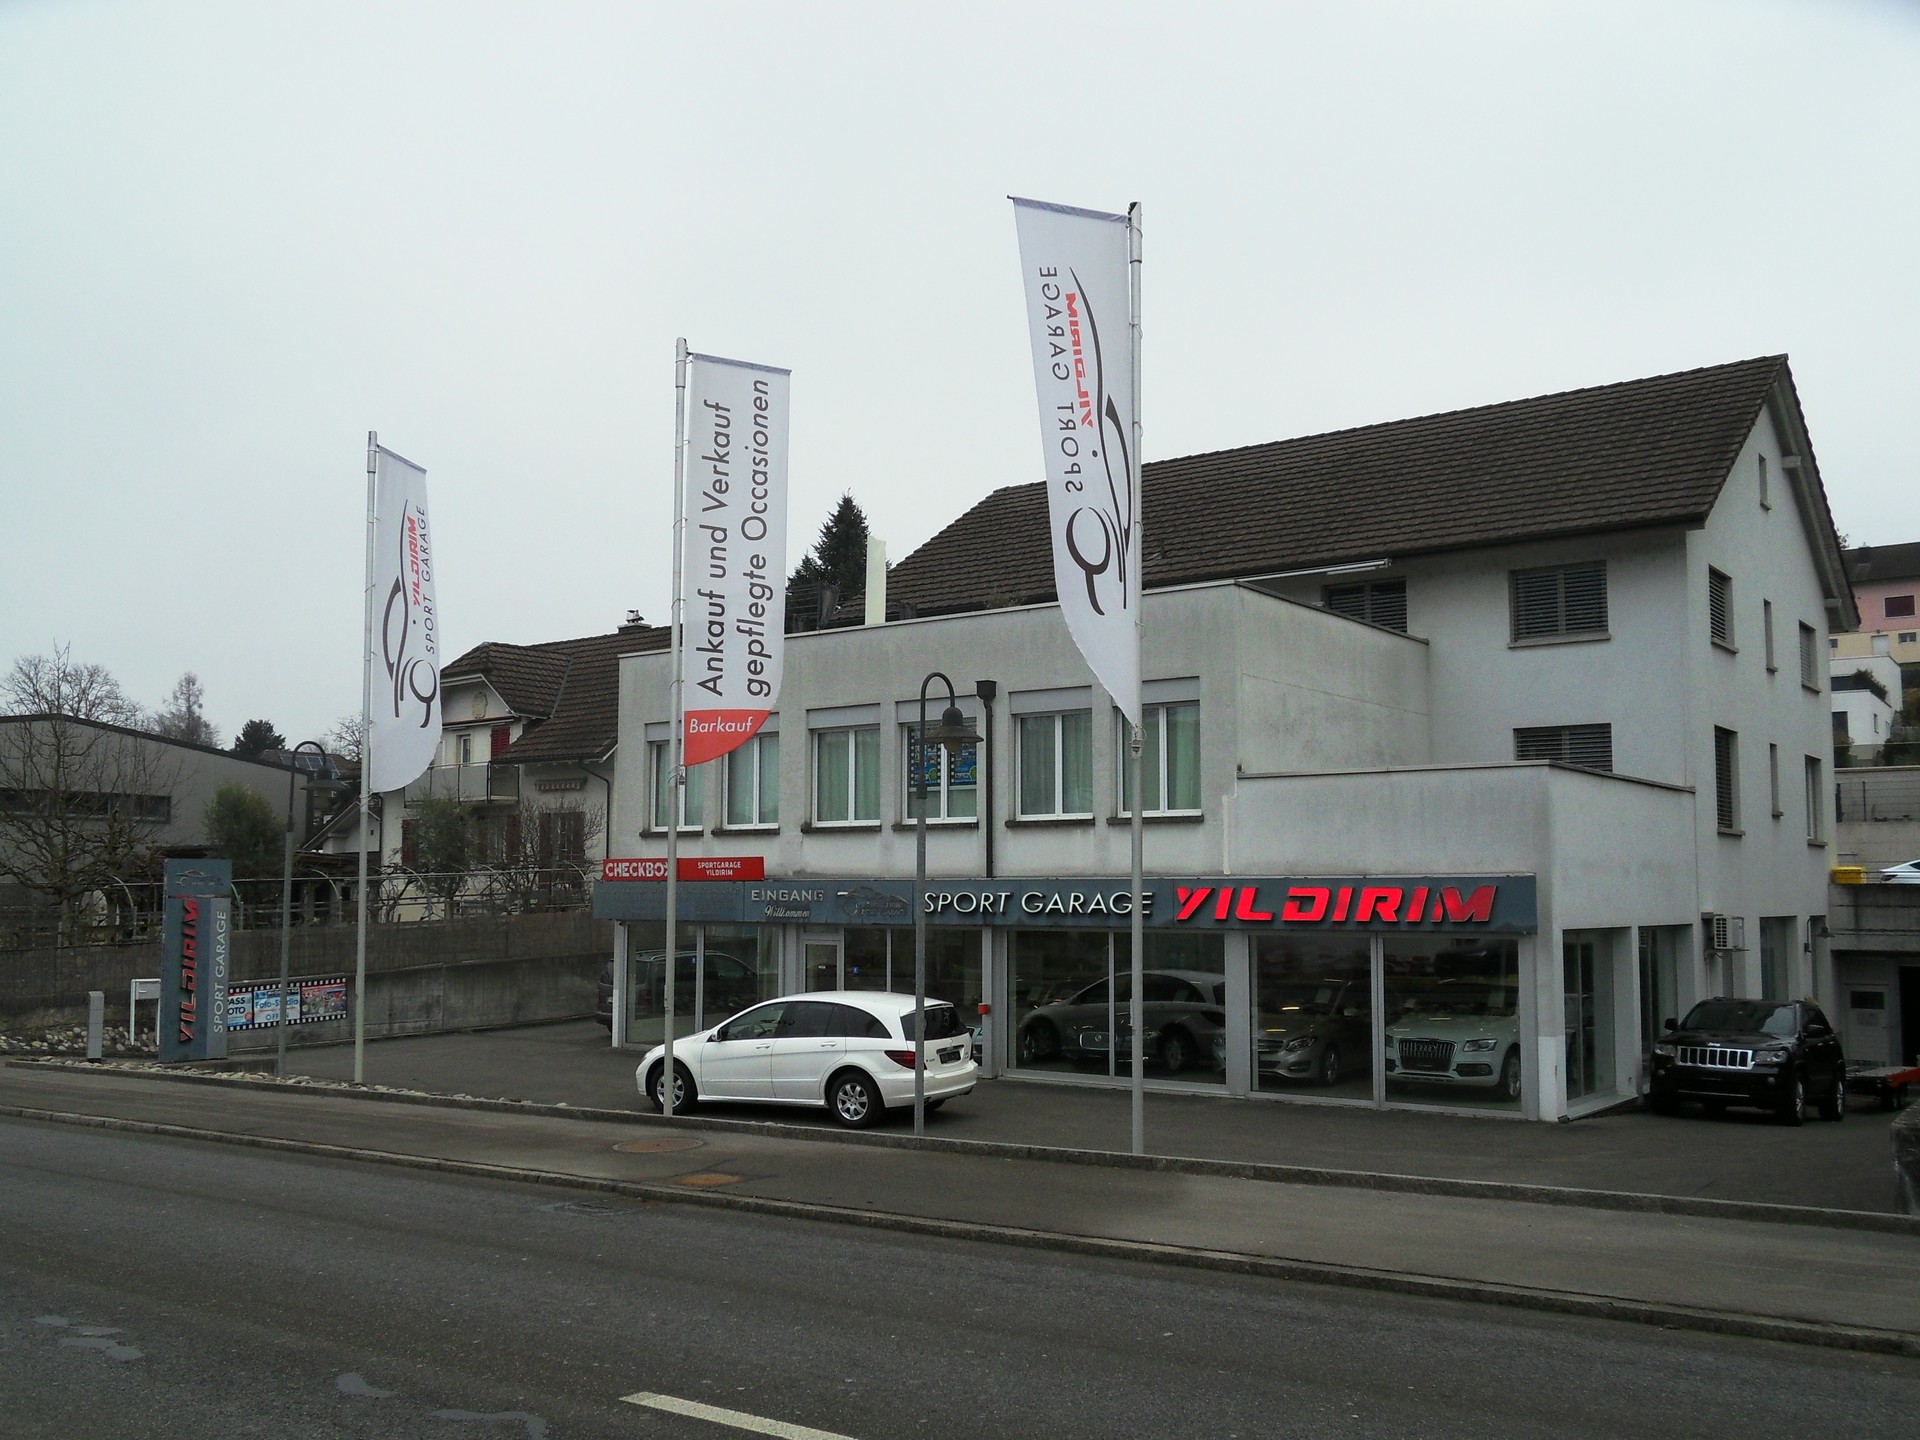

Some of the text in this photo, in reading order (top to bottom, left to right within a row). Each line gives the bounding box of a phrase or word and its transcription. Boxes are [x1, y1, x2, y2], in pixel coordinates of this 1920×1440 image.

[407, 515, 421, 607] YILDIRIM
[696, 399, 731, 697] Ankauf und Verkauf
[736, 379, 774, 698] gepflegte Occasionen
[416, 505, 435, 655] SPORT GARAGE
[689, 716, 753, 734] Barkauf
[697, 861, 742, 869] SPORTGARAGE
[764, 904, 811, 918] Willkommen
[924, 891, 1011, 914] SPORT
[1021, 891, 1154, 915] GARAGE
[1176, 885, 1498, 923] YILDIRIM
[180, 898, 199, 1042] YILDIRIM
[213, 911, 227, 1033] SPORT GARAGE
[227, 1006, 246, 1015] OTO
